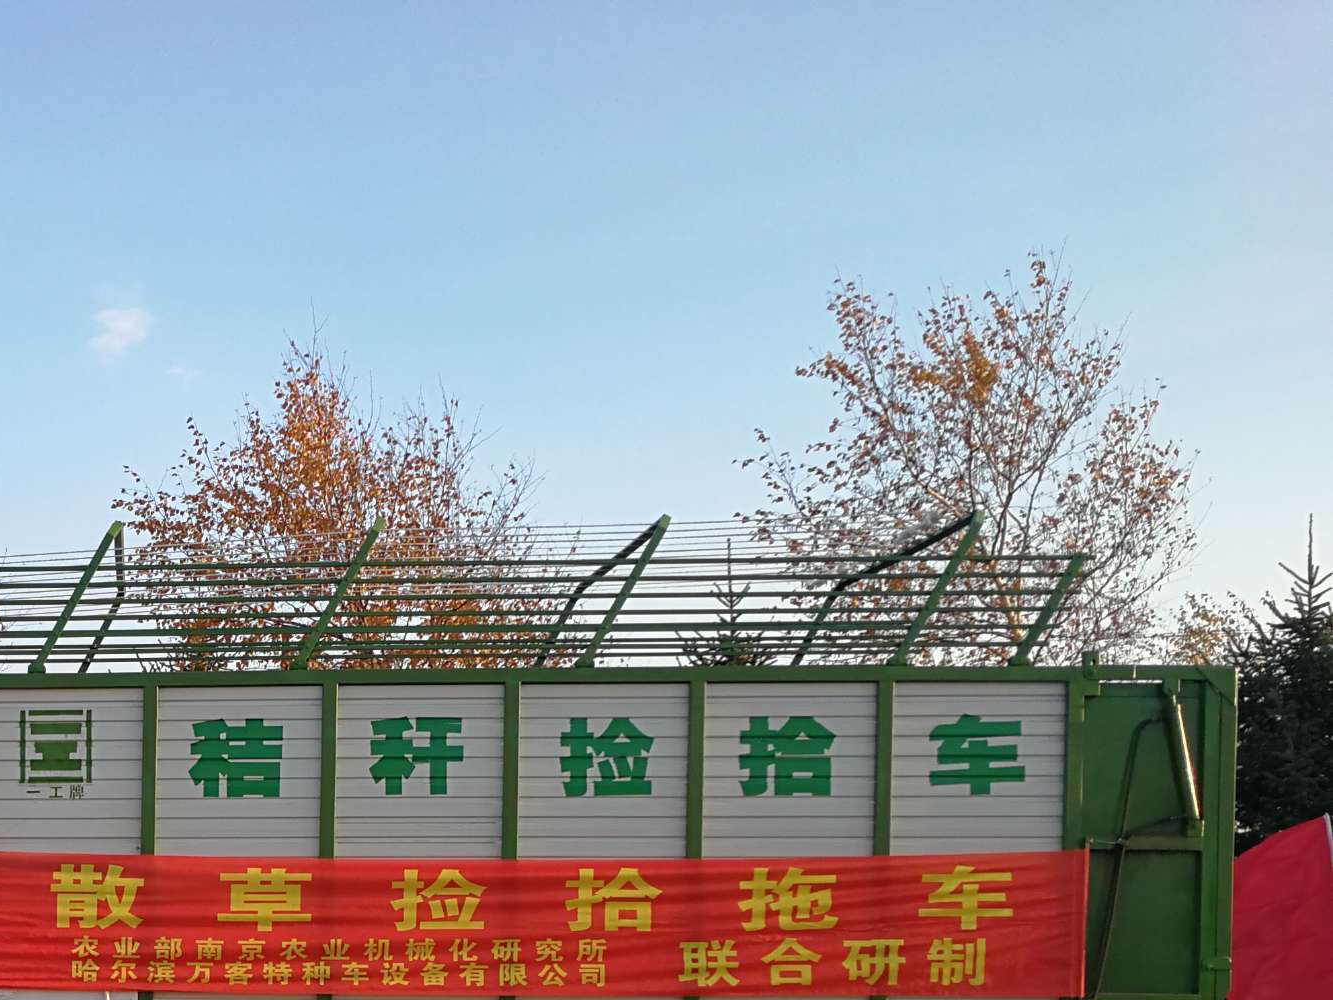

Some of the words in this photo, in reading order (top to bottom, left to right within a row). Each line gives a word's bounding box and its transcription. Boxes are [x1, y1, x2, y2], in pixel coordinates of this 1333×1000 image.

[50, 864, 1014, 932] 散草捡拾拖车
[71, 936, 607, 962] 农业部南京农业机械化研究所
[679, 938, 987, 987] 联合研制
[71, 960, 606, 987] 哈尔滨万客特种车设备有限公司
